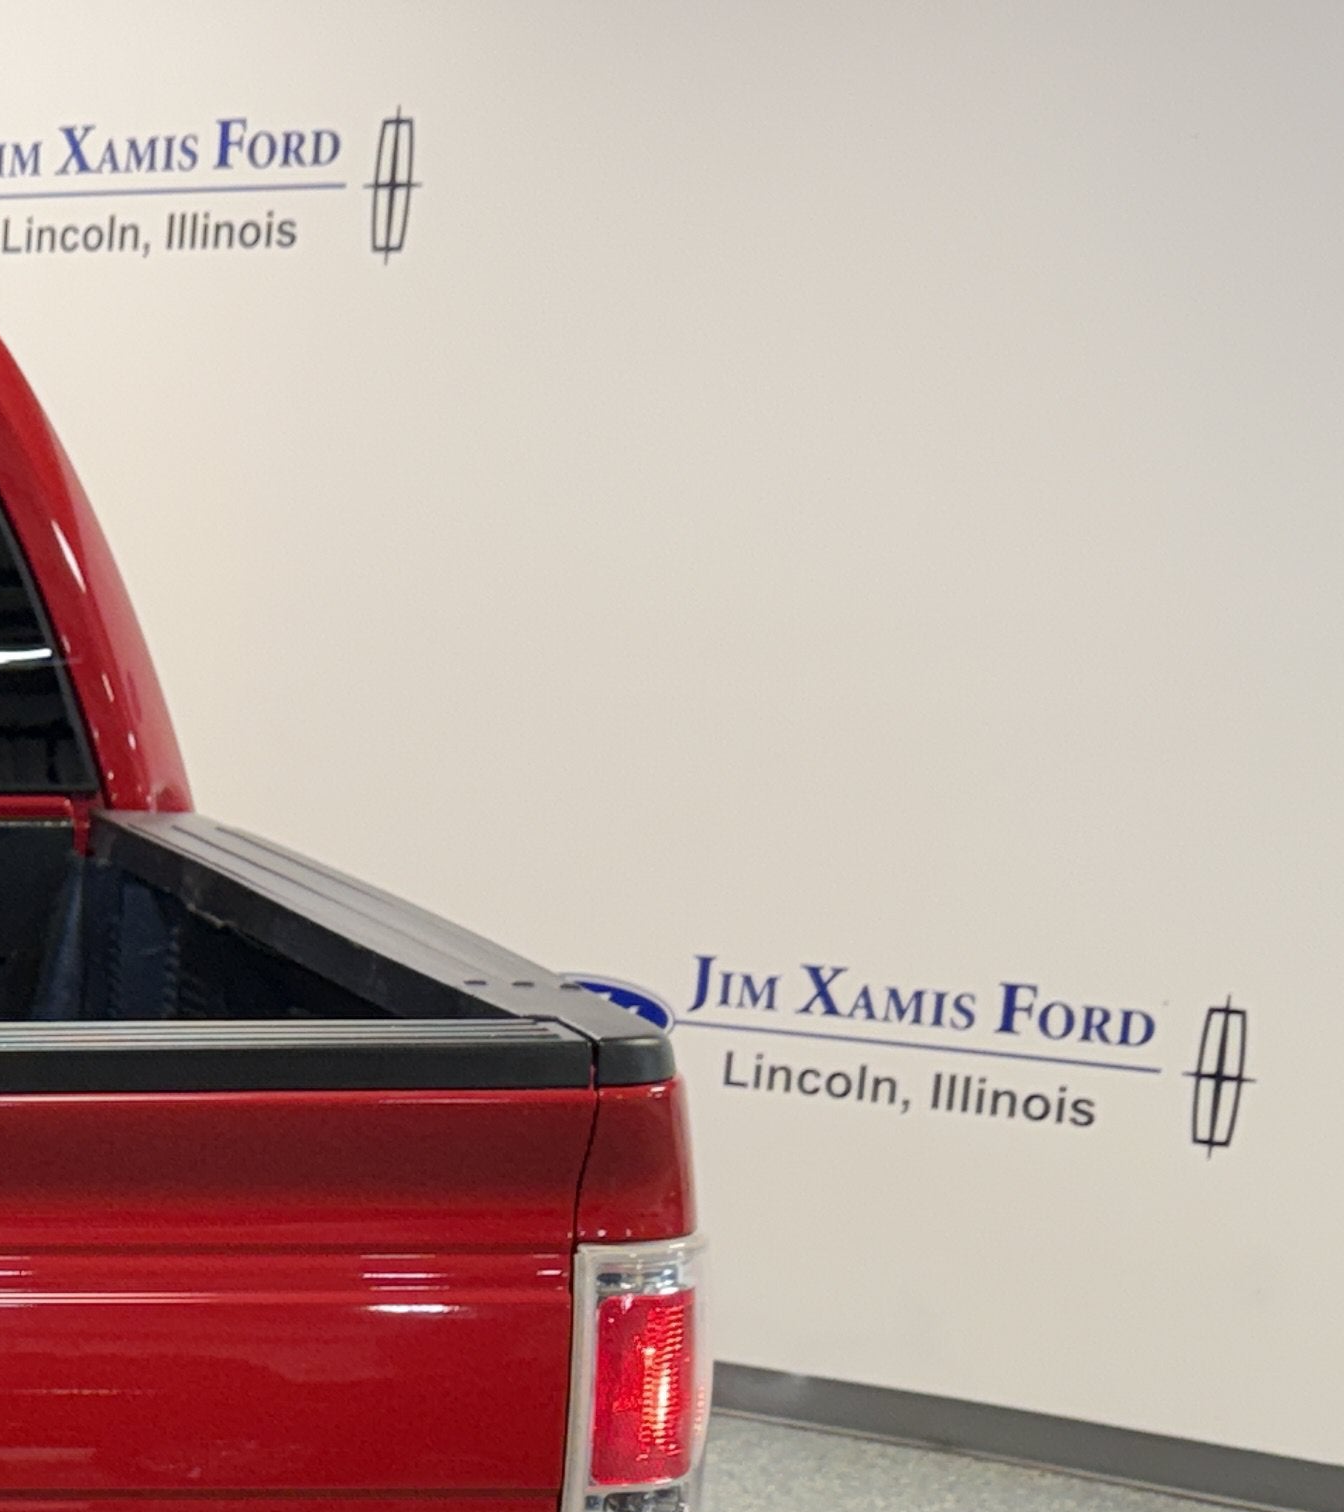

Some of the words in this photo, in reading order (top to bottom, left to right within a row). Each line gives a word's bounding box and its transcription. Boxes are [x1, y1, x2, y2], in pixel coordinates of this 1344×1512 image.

[54, 124, 199, 176] XAMIS
[213, 118, 342, 171] FORD
[1, 215, 152, 257] Lincoln,
[166, 211, 298, 251] Illinois
[686, 955, 779, 1013] JIM
[793, 964, 976, 1031] XAMIS
[994, 982, 1156, 1049] FORD
[723, 1050, 912, 1114] Lincoln,
[929, 1072, 1097, 1129] Illinois
